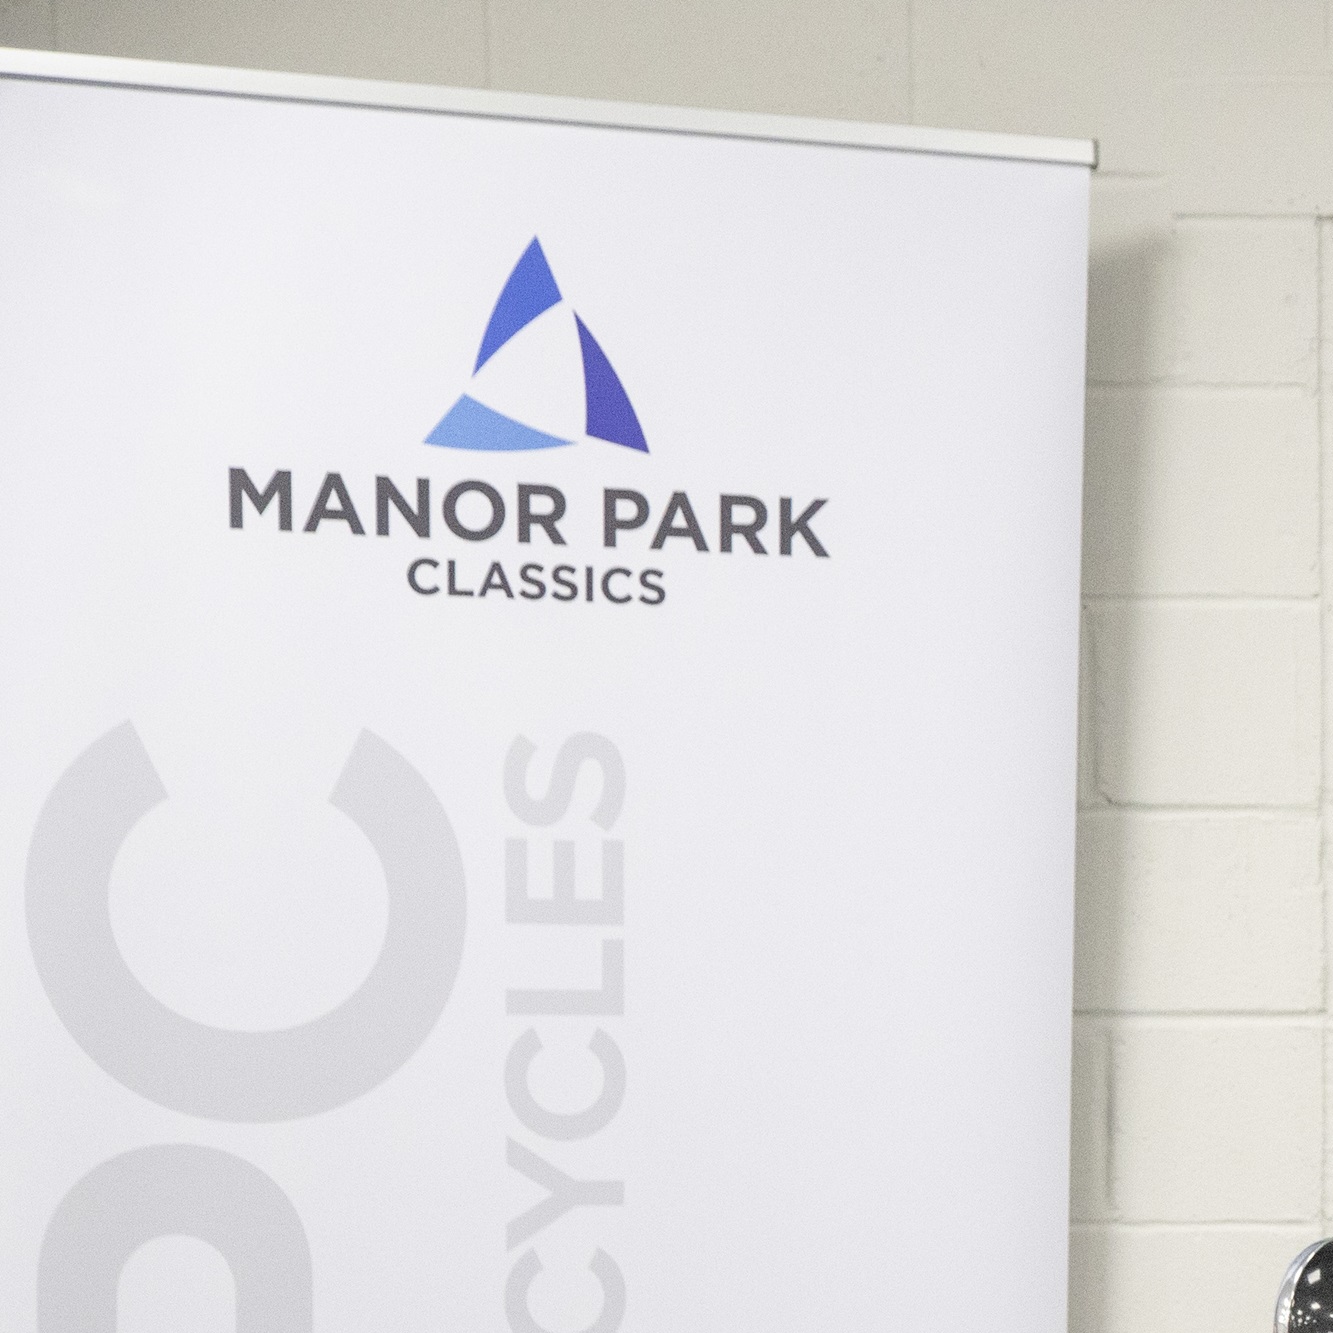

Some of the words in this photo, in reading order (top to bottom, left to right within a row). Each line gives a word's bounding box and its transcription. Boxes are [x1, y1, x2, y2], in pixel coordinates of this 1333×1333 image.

[229, 467, 567, 546] MANOR
[603, 487, 830, 558] PARK
[407, 557, 667, 606] CLASSICS
